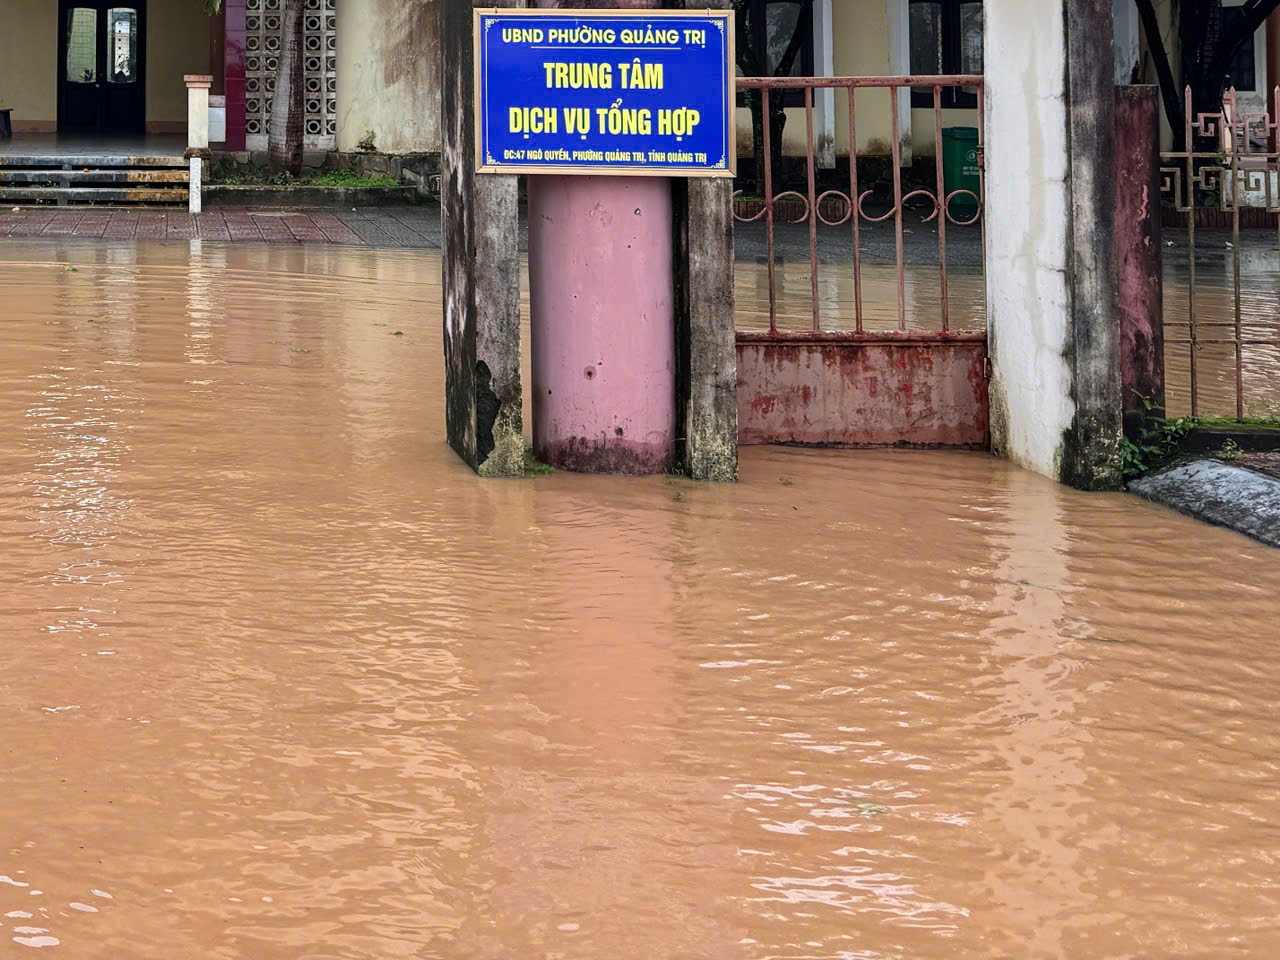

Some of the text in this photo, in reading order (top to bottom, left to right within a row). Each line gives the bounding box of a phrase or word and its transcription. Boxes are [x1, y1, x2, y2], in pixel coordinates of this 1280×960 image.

[502, 24, 706, 49] UBND PHƯỜNG QUẢNG TRỊ
[543, 57, 664, 90] TRUNG TÂM
[509, 98, 700, 142] DỊCH VỤ TỔNG HỢP
[527, 148, 543, 160] NGÔ
[572, 148, 604, 161] PHƯỜNG
[605, 148, 631, 163] QUẢNG
[632, 151, 647, 164] TRỊ,
[648, 149, 666, 163] TỈNH
[667, 149, 694, 164] QUẢNG
[694, 152, 707, 165] TRỊ
